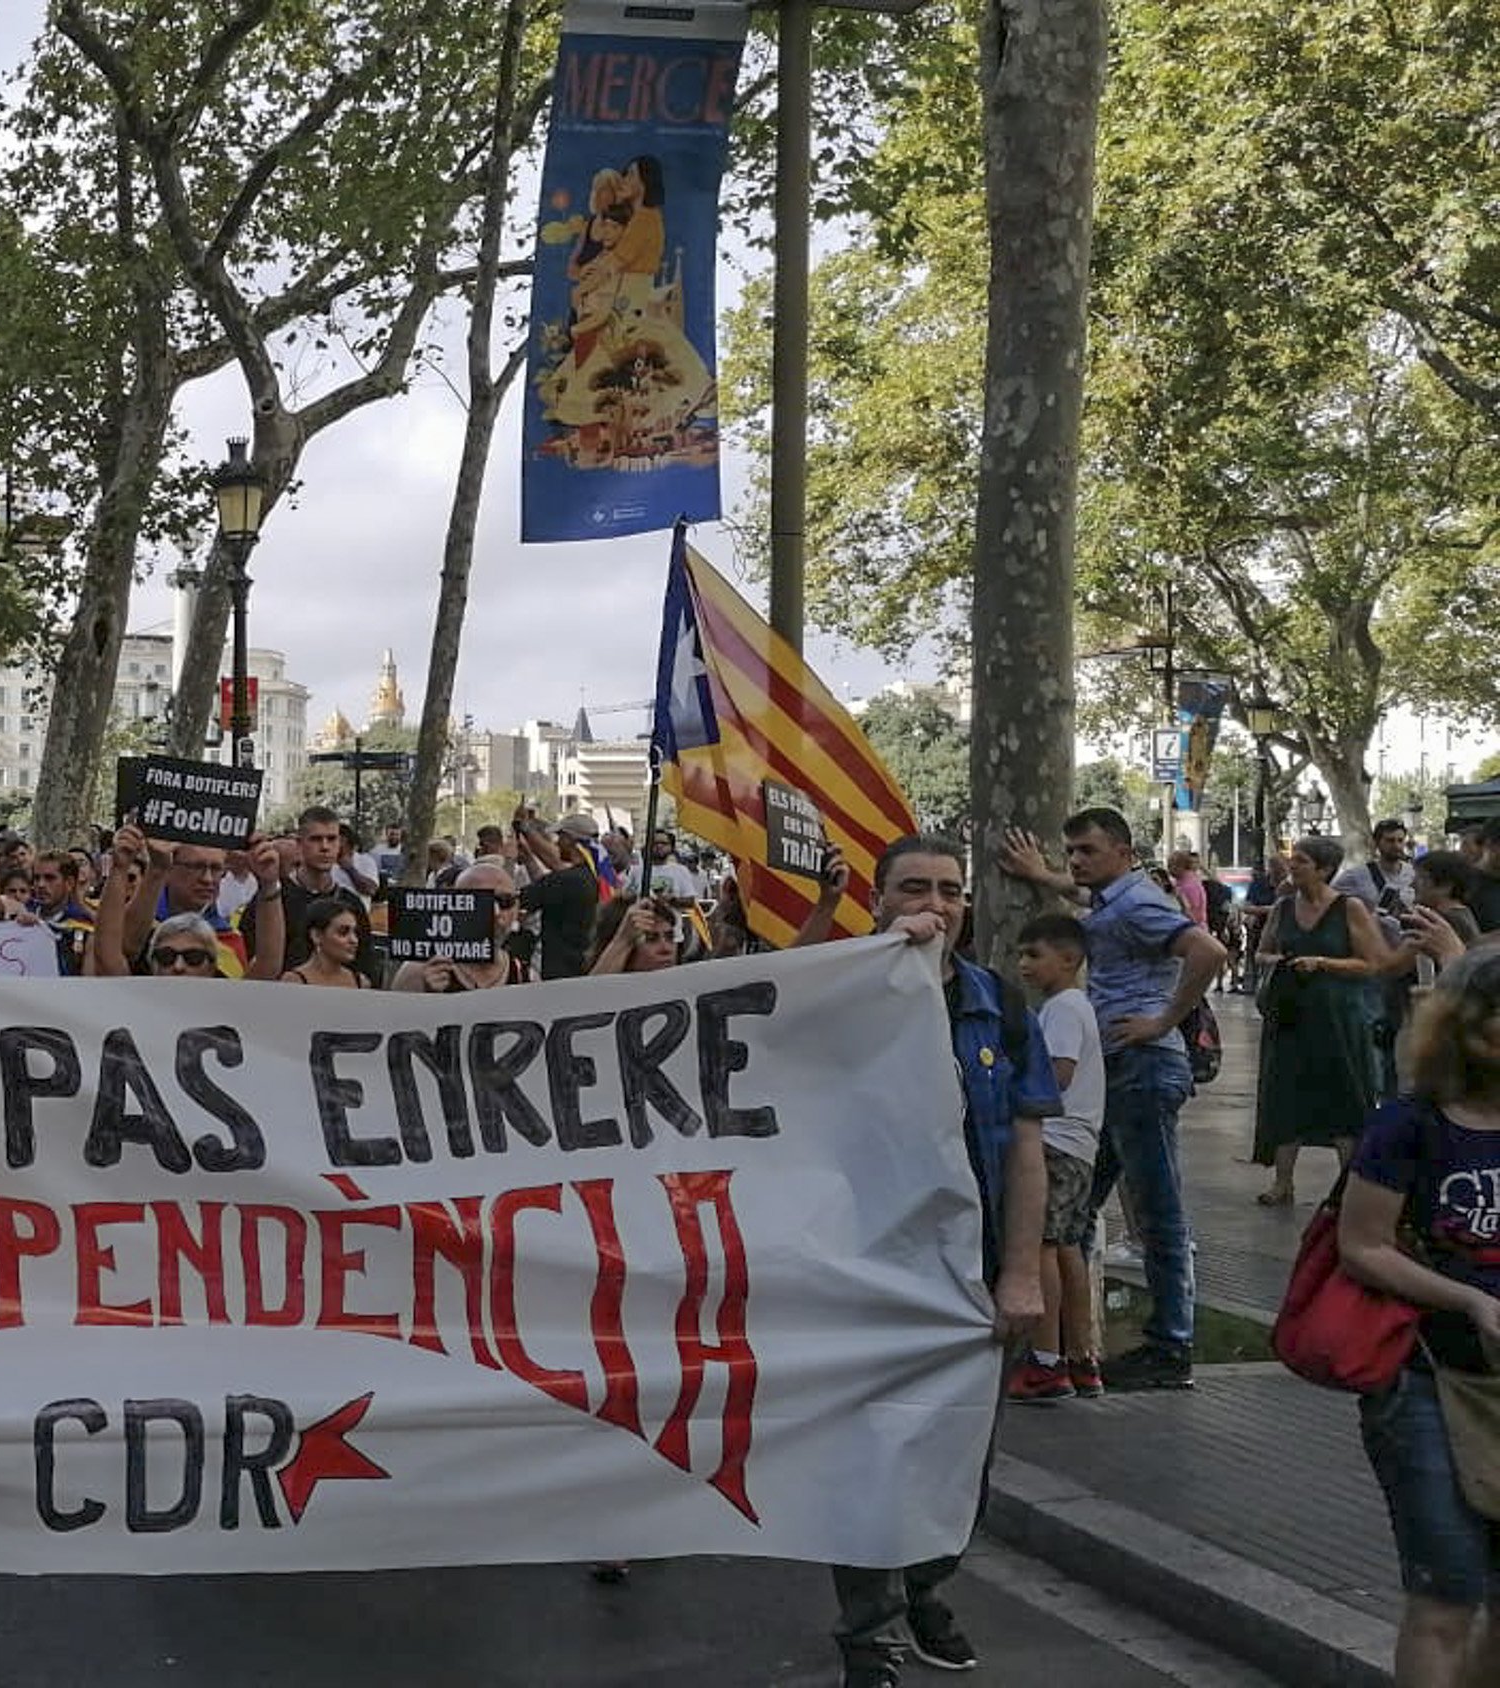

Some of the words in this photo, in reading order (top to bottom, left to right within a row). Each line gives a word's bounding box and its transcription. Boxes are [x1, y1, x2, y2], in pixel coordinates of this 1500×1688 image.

[145, 768, 183, 789] FORA
[185, 774, 259, 799] BOTIFLERS
[405, 892, 475, 911] BOTIFLER
[426, 914, 453, 938] JO
[392, 940, 412, 956] NO
[414, 941, 432, 957] ET
[434, 937, 491, 959] VOTARÉ
[308, 978, 781, 1168] ENRERE
[33, 1394, 299, 1534] CDR
